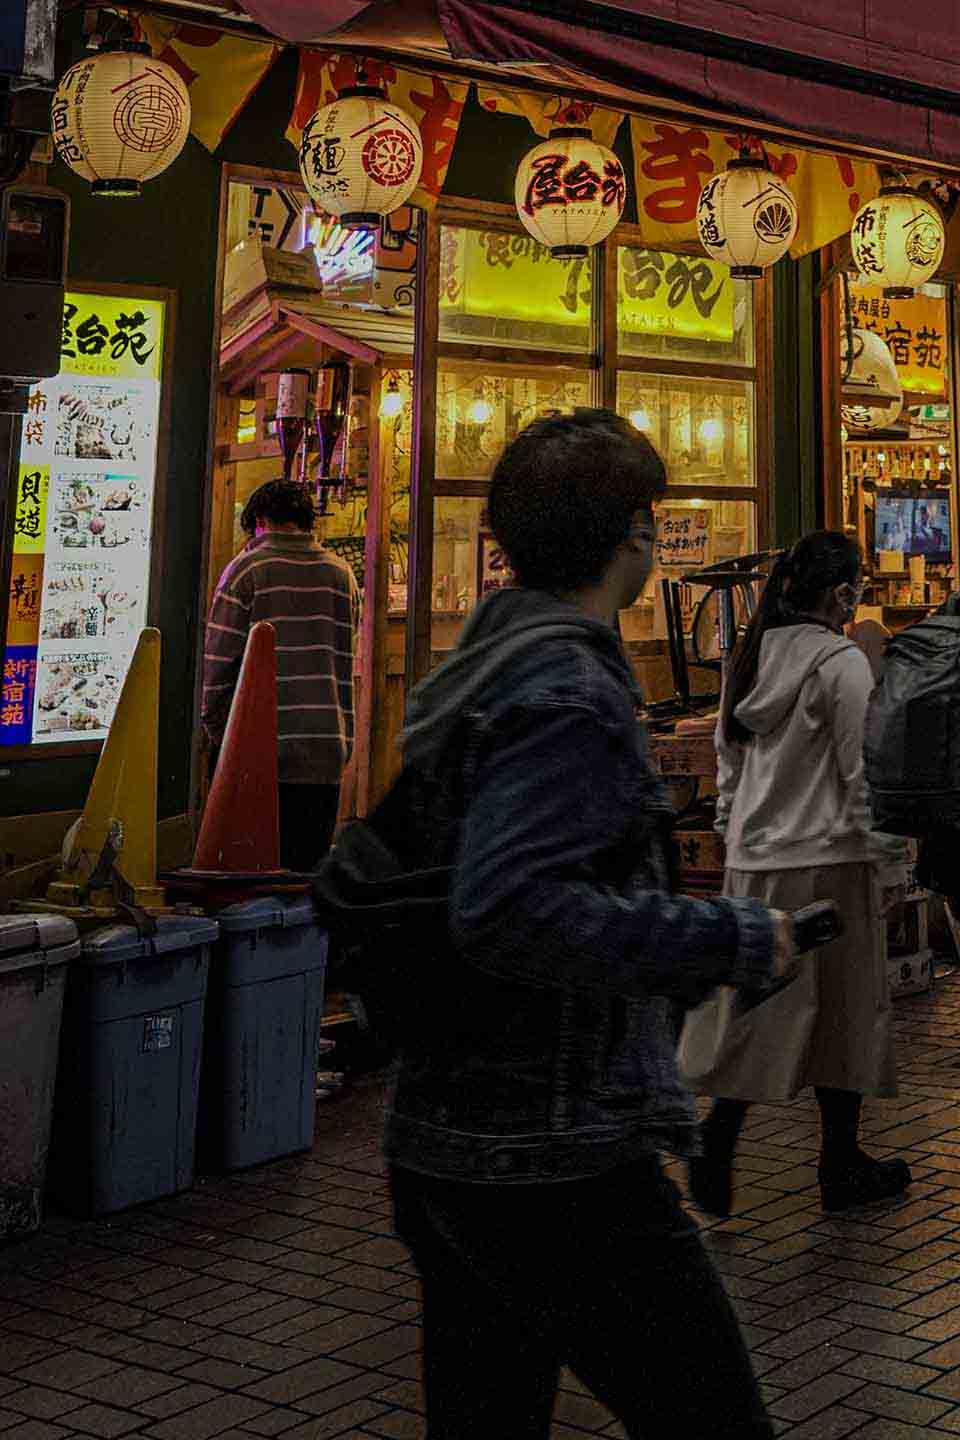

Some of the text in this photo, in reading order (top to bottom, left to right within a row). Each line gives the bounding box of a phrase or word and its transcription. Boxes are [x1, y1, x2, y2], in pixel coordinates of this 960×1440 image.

[521, 153, 625, 216] 屋台苑
[854, 206, 885, 275] 布袋
[14, 470, 42, 539] 貝道
[1, 658, 29, 727] 新宿苑
